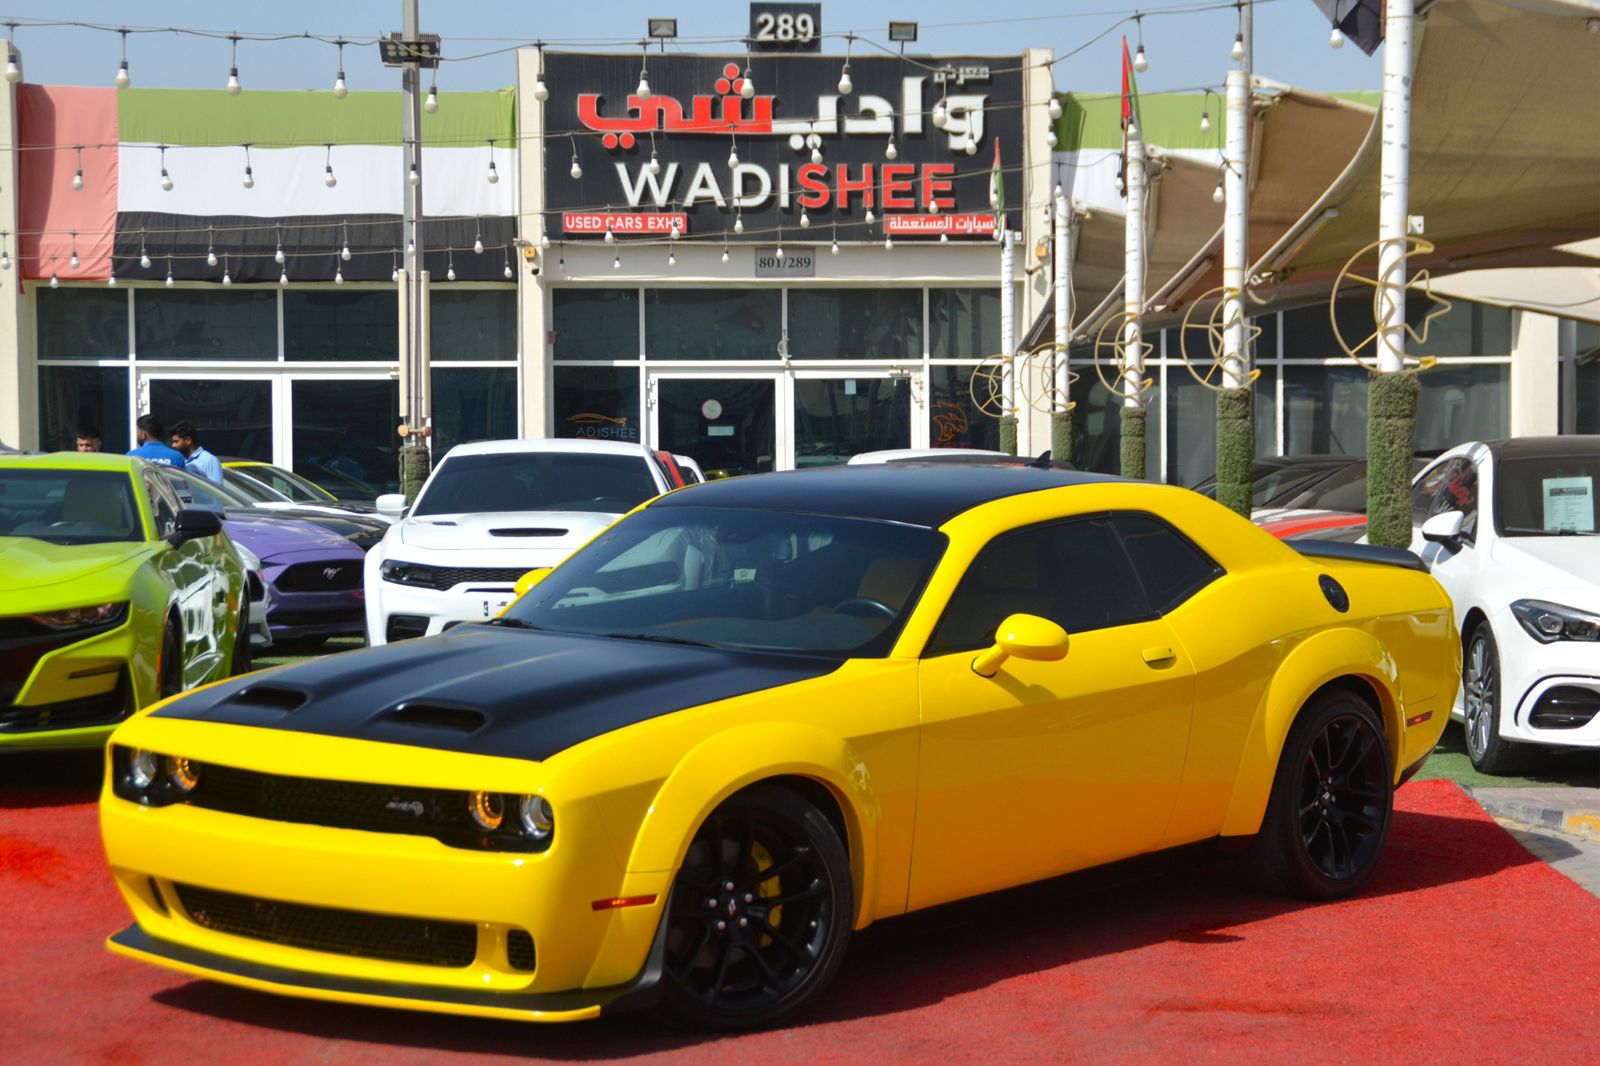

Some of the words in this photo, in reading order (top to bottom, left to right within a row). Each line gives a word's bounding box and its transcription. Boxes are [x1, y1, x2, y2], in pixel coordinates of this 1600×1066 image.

[756, 12, 815, 42] 289
[615, 162, 955, 208] WADISHEE
[565, 216, 601, 229] USED
[606, 216, 643, 229] CARS
[647, 216, 684, 229] EXHB
[889, 216, 953, 230] المستعملة
[759, 256, 811, 269] 801/289
